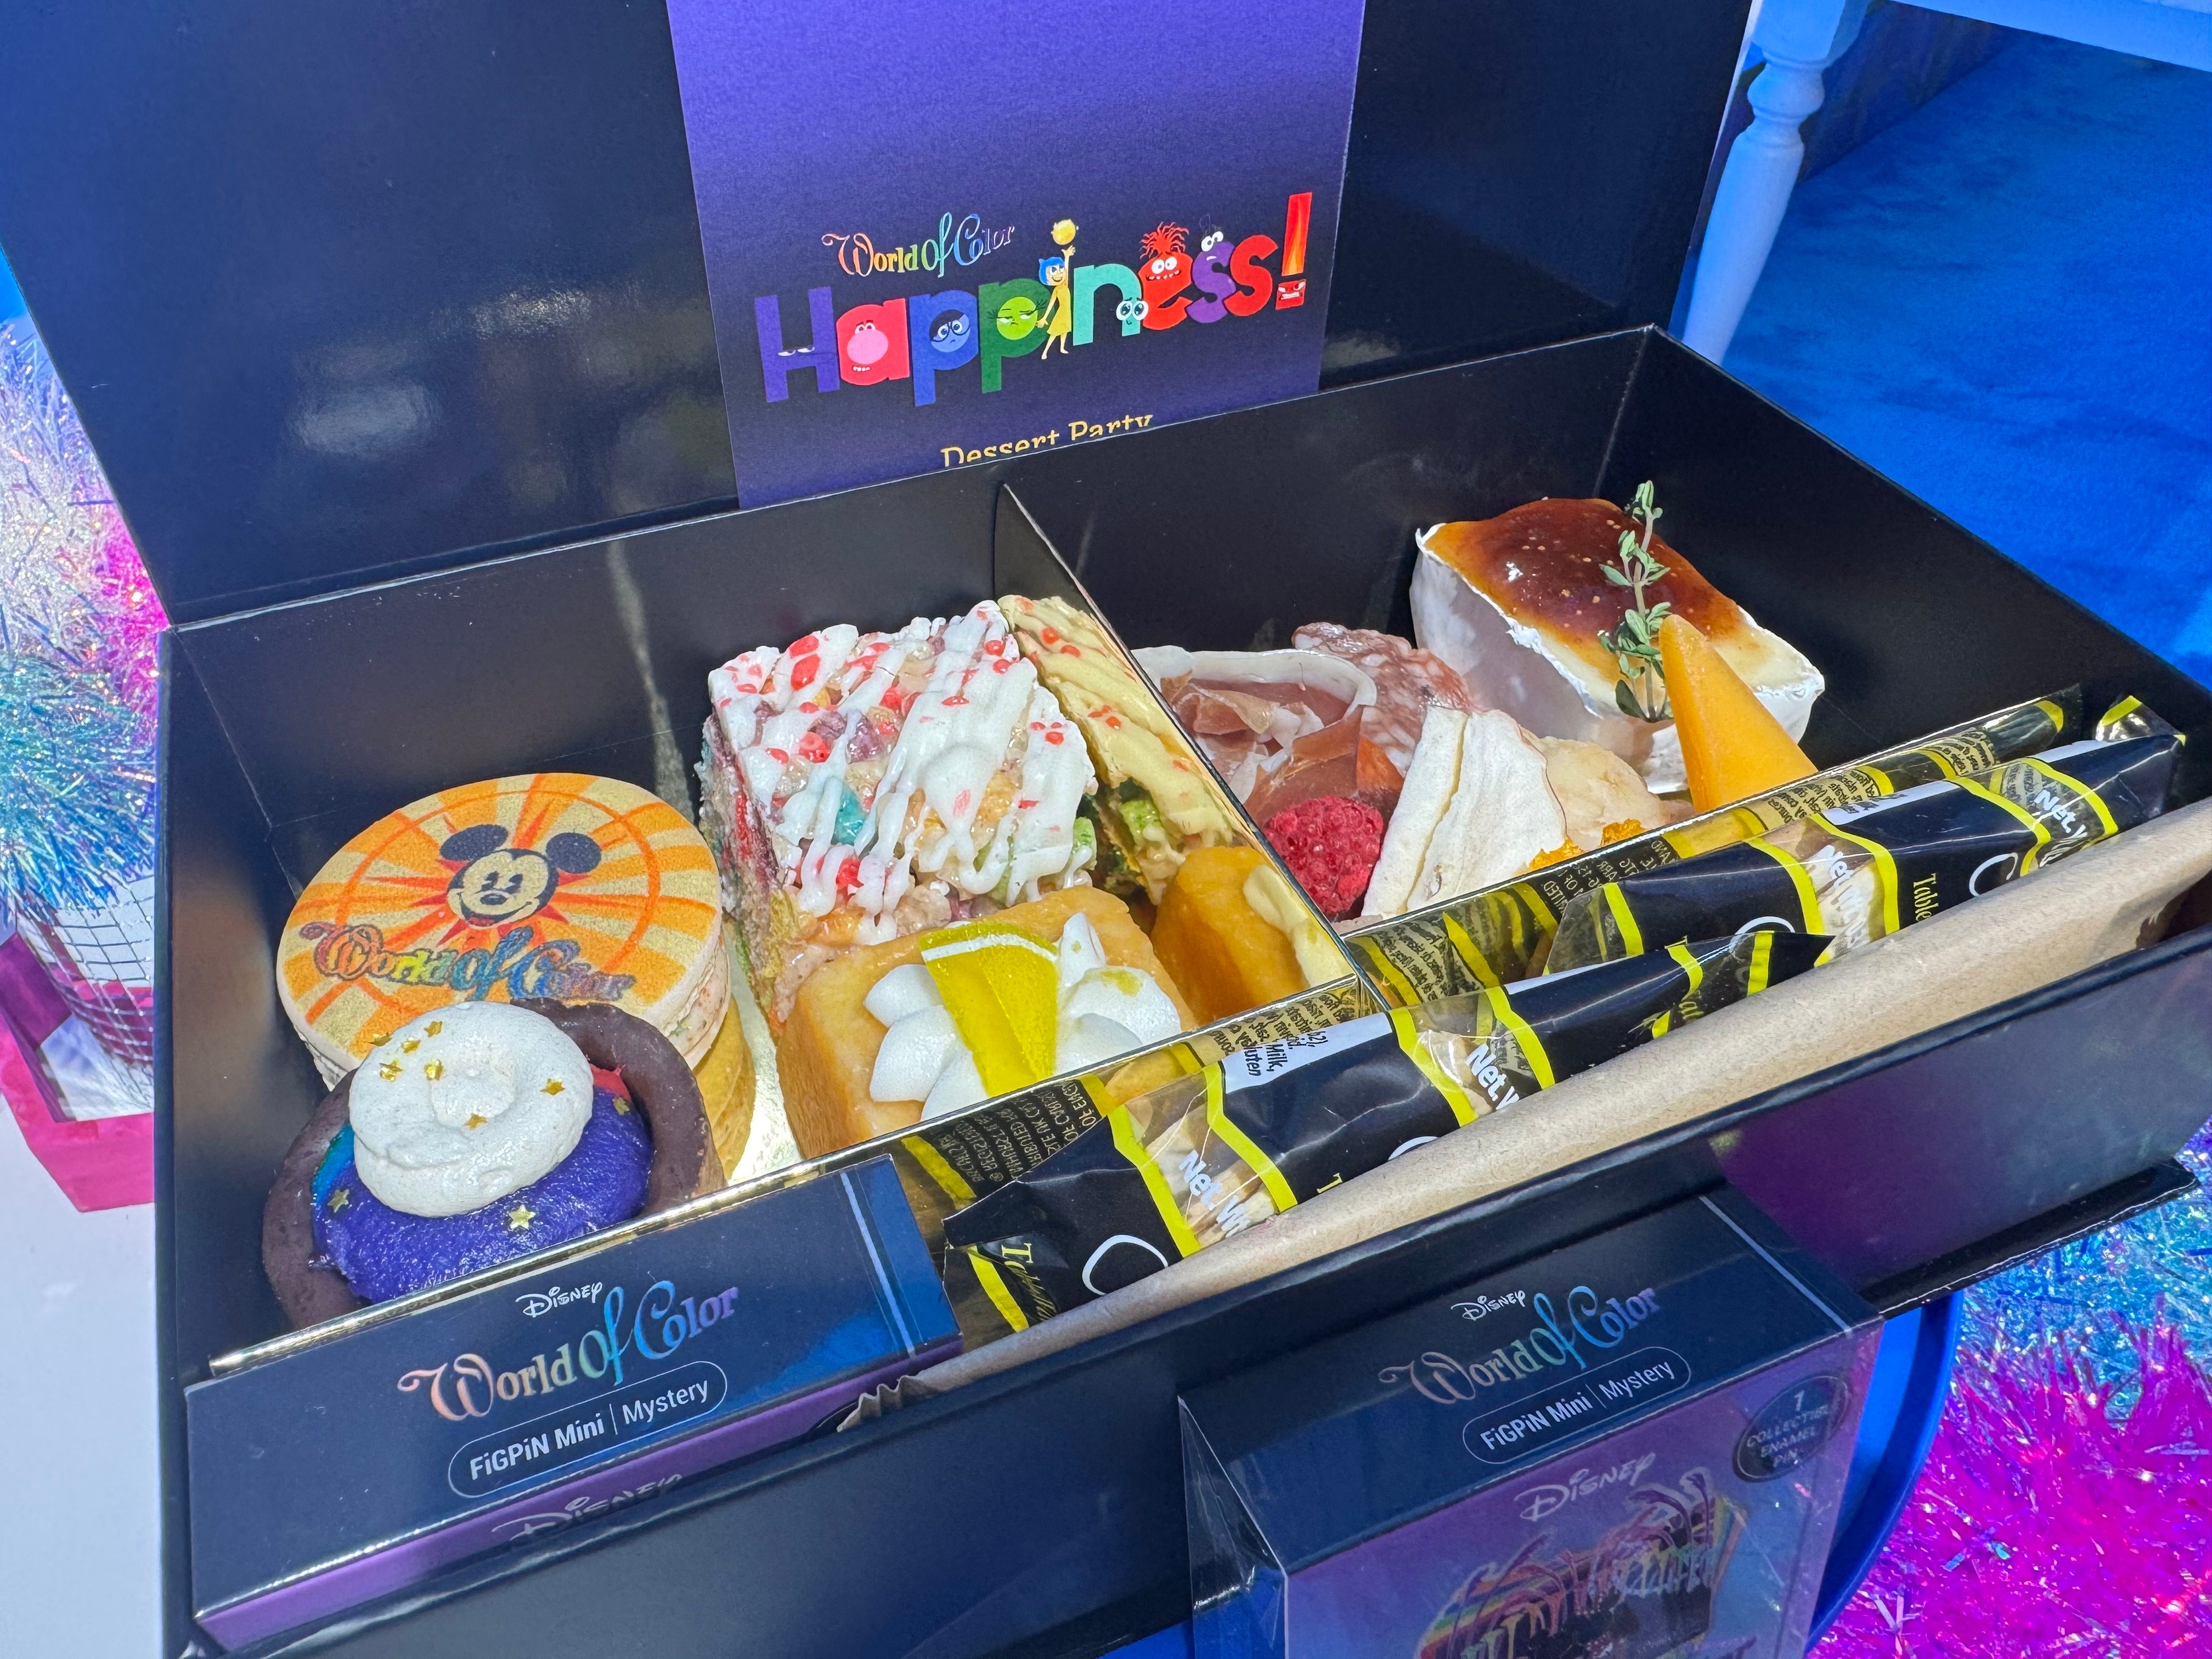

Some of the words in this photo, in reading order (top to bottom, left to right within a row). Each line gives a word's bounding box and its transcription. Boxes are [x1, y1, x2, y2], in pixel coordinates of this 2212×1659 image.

[821, 233, 919, 277] World
[953, 213, 1015, 267] Color
[940, 430, 1060, 467] Dessert
[1068, 414, 1153, 441] Party
[1465, 1043, 1507, 1102] Net
[1180, 1149, 1223, 1210] Net
[397, 1343, 577, 1421] World
[634, 1280, 739, 1359] Color
[1378, 1339, 1544, 1404] World
[1569, 1285, 1661, 1348] Color
[470, 1433, 549, 1481] FiGPiN
[554, 1413, 605, 1450] Mini
[622, 1380, 708, 1424] Mystery
[1480, 1410, 1551, 1450] FiGPiN
[1545, 1391, 1593, 1423] Mini
[1598, 1361, 1675, 1400] Mystery
